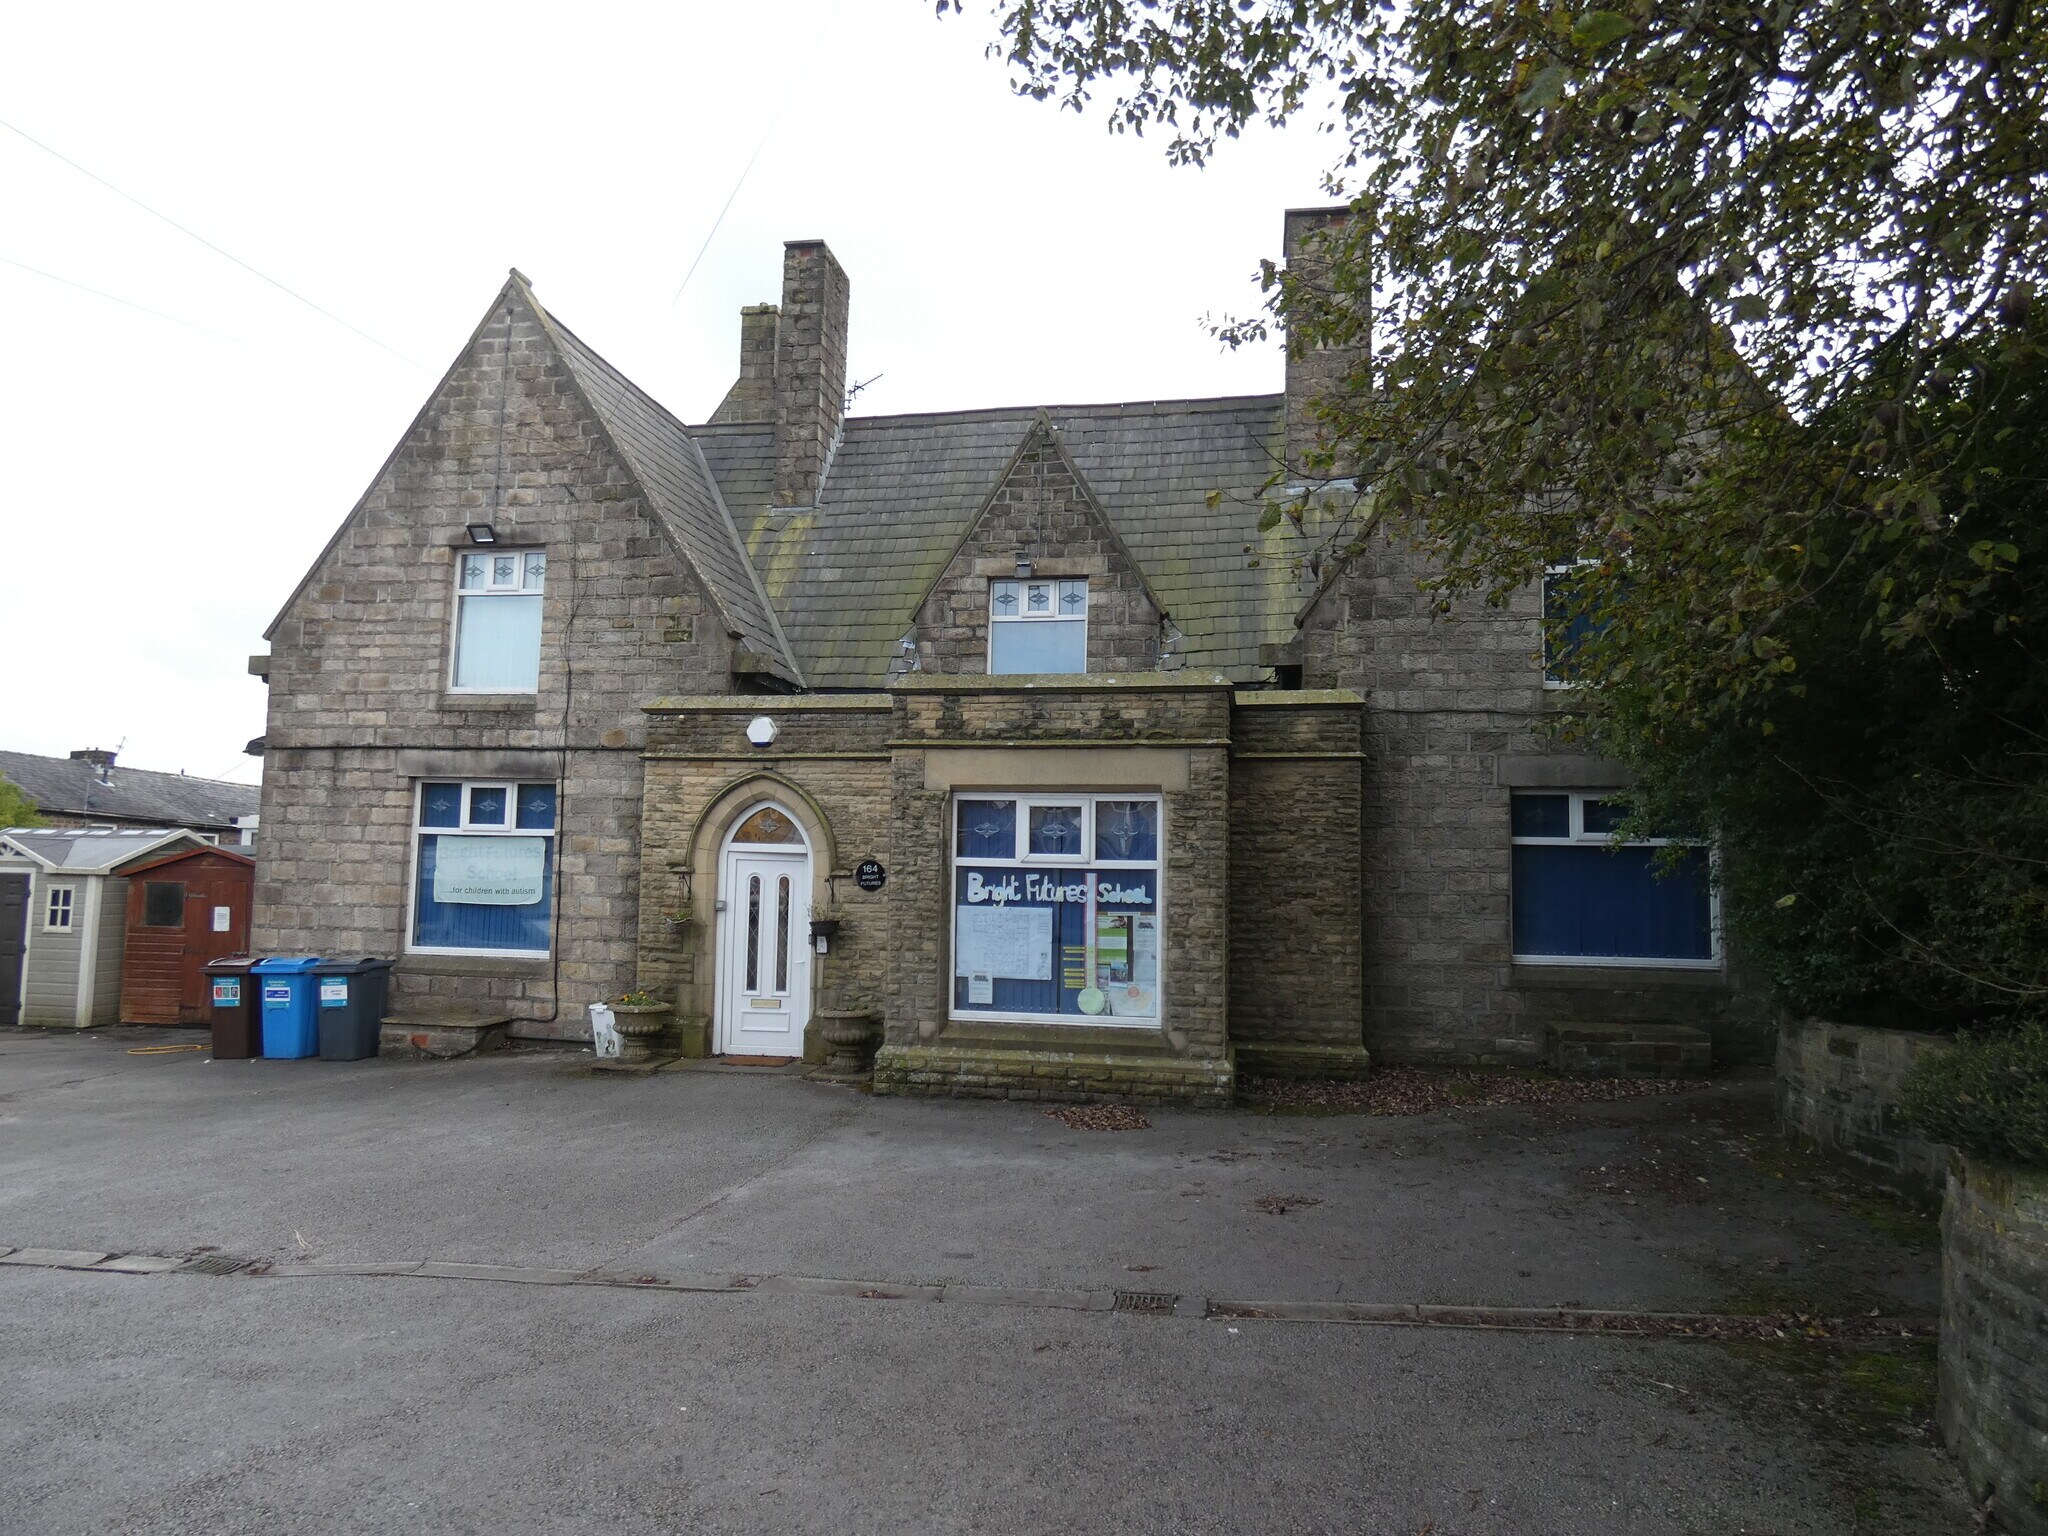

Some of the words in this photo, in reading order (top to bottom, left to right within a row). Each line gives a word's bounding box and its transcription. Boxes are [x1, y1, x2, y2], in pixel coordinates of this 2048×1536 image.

[862, 864, 878, 873] 164
[464, 886, 493, 895] children
[494, 887, 510, 895] with
[511, 887, 536, 895] autism
[967, 872, 1022, 908] Bright
[1025, 873, 1088, 903] Futures
[1097, 883, 1152, 904] School
